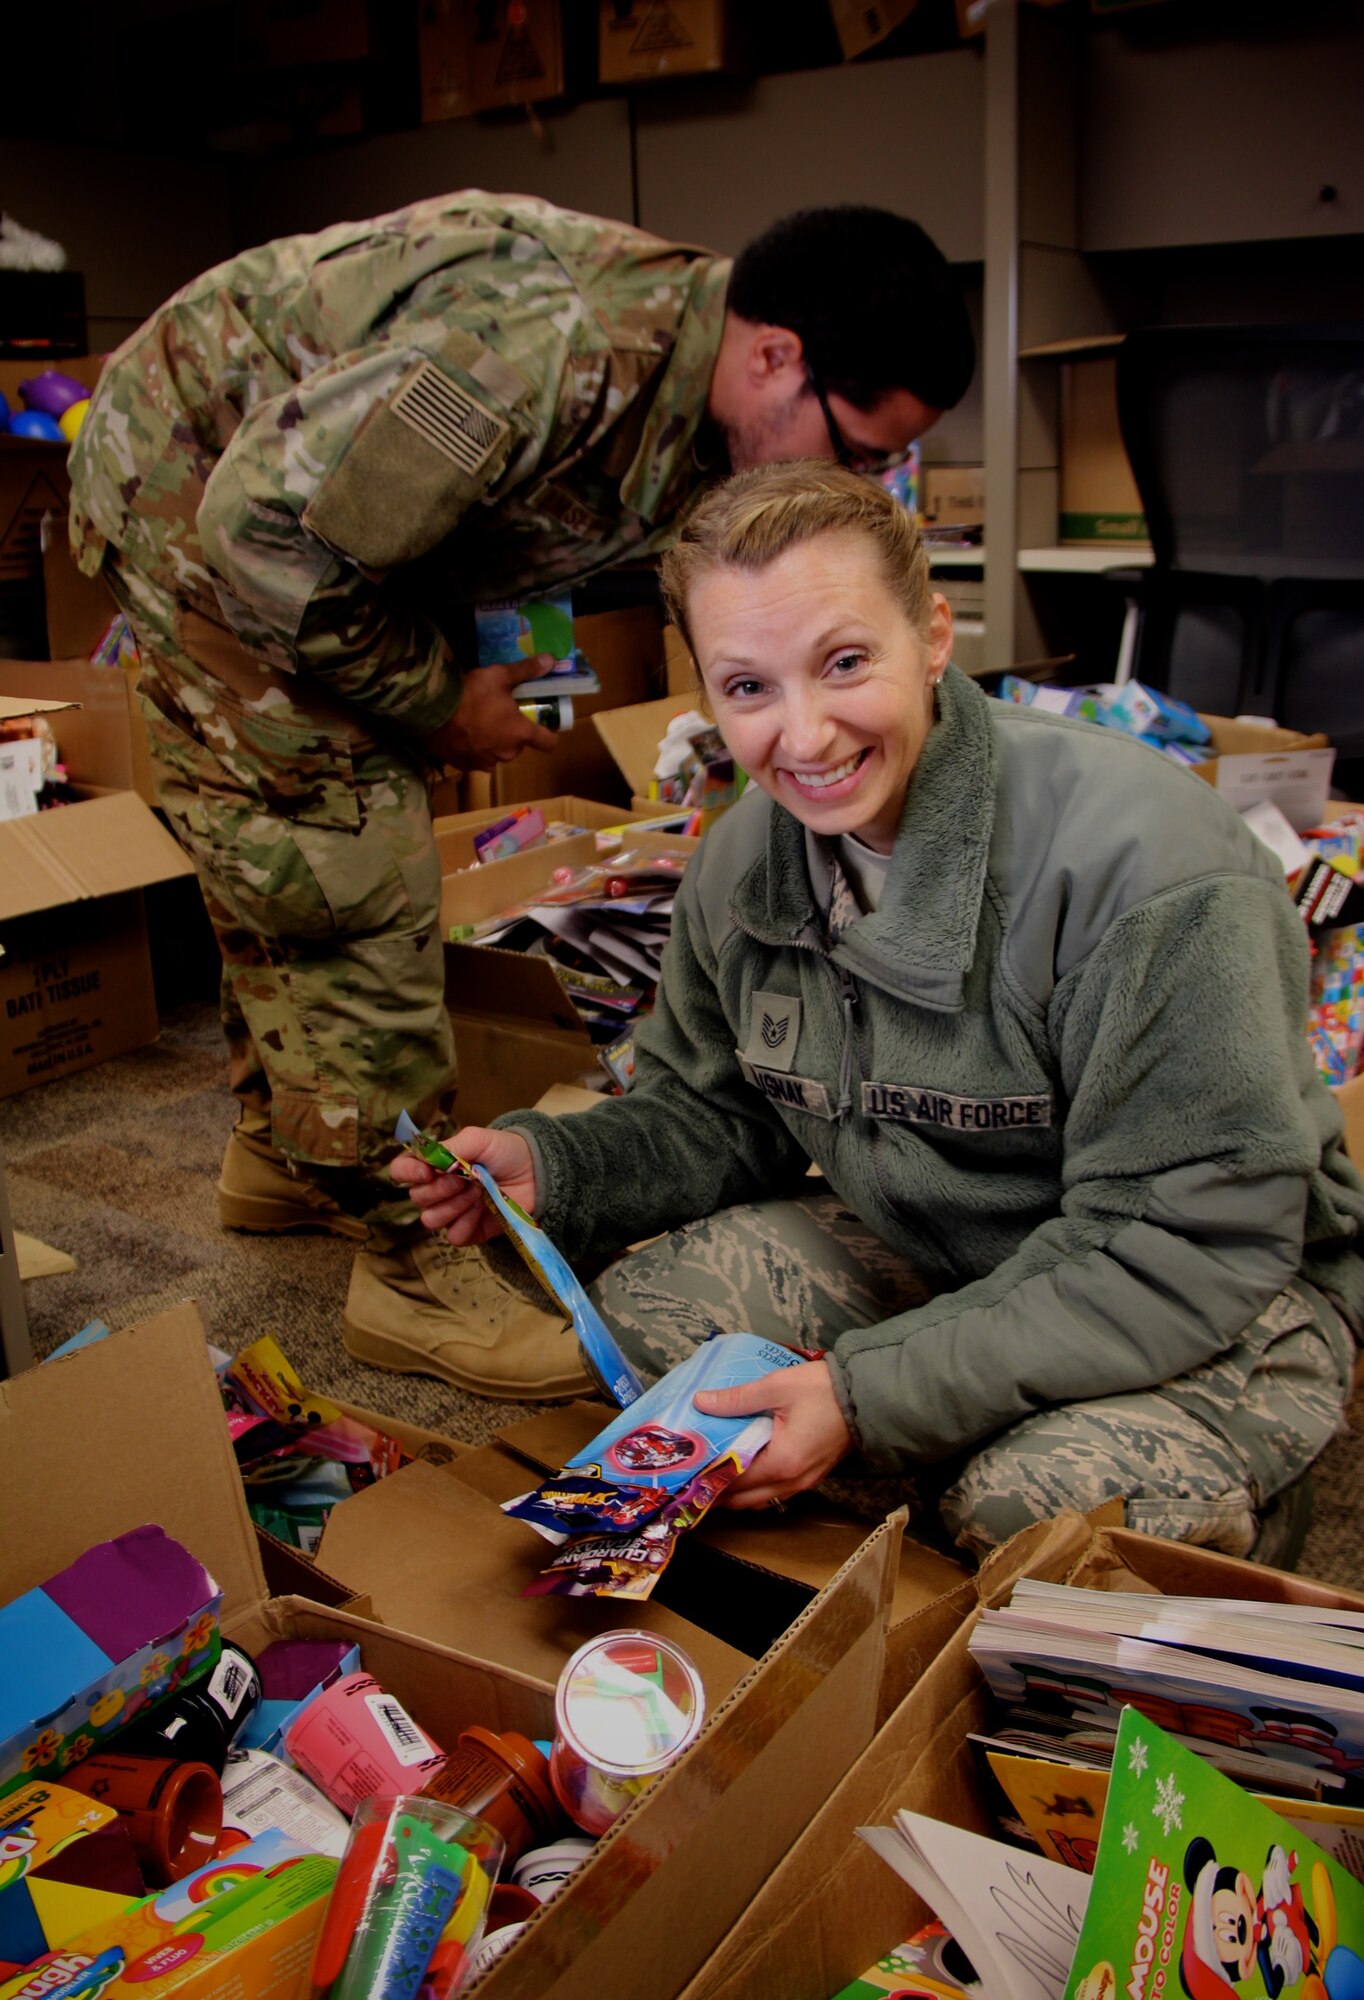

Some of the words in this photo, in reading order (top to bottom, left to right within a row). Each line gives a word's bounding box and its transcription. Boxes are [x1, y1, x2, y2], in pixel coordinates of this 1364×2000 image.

[47, 971, 100, 1003] TISSUE
[917, 1094, 954, 1125] AIR
[960, 1101, 1041, 1129] FORCE
[240, 1362, 284, 1414] MICKEY
[1126, 1856, 1169, 2000] MOUSE
[1150, 1968, 1166, 2000] TO
[1159, 1882, 1182, 1966] COLOR
[9, 1955, 95, 2000] ugh
[151, 1964, 163, 1972] &
[160, 1949, 188, 1966] FLUO
